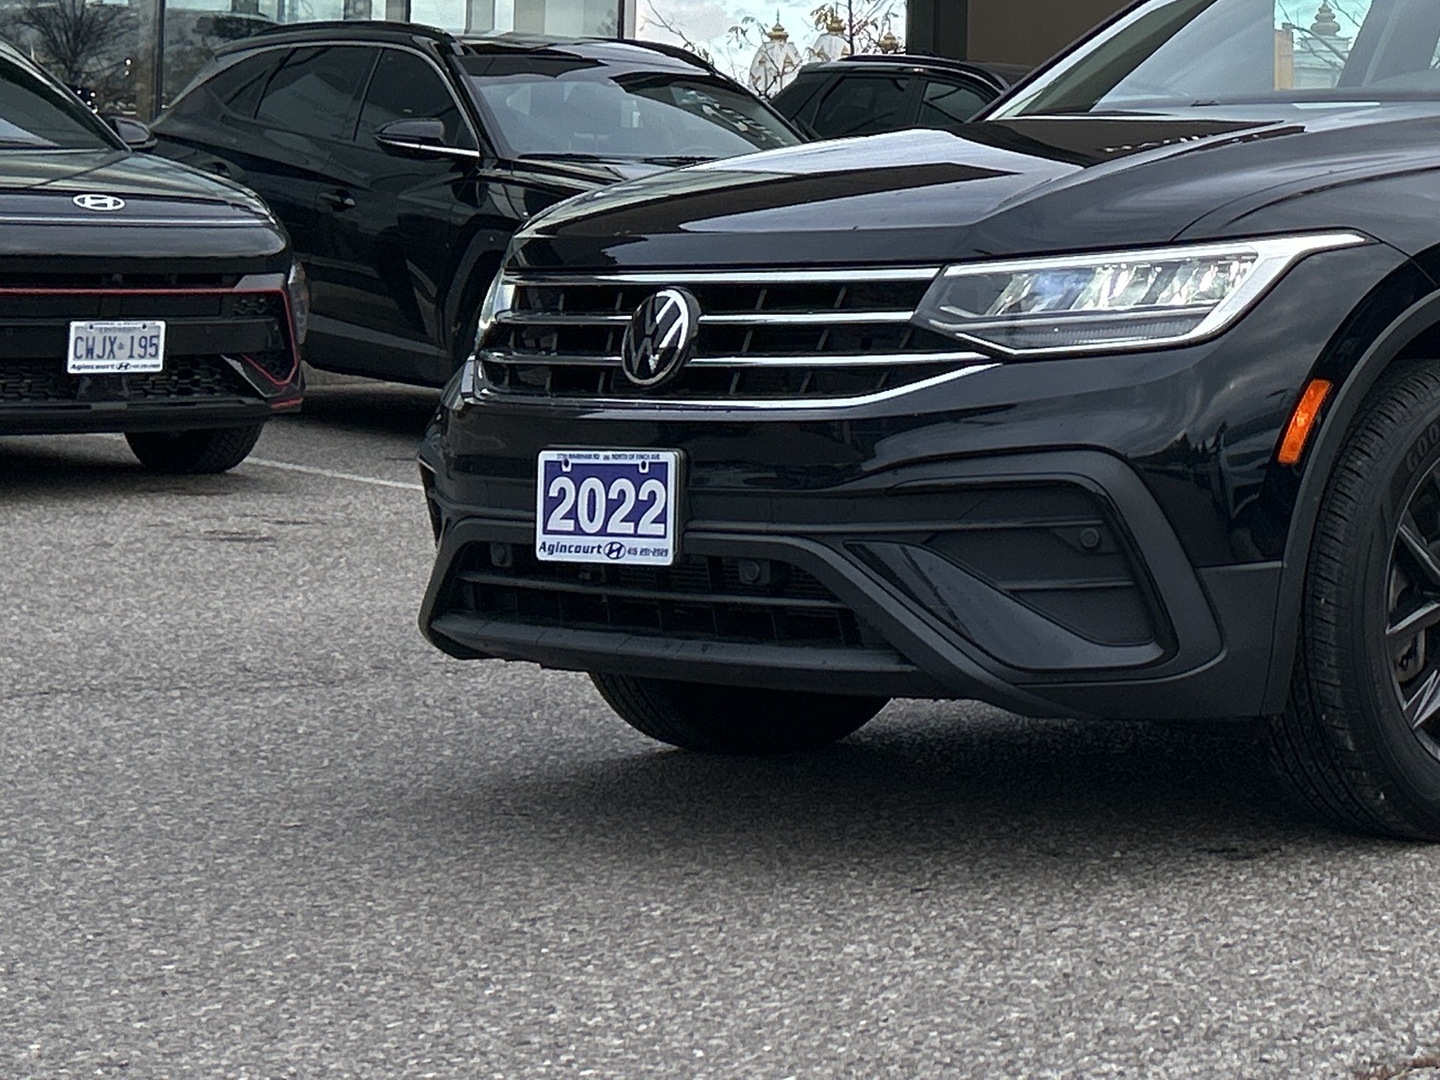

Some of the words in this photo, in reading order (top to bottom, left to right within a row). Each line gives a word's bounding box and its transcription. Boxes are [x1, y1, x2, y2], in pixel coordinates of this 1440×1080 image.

[128, 335, 160, 359] 195
[547, 476, 667, 535] 2022
[538, 541, 603, 556] Agincourt
